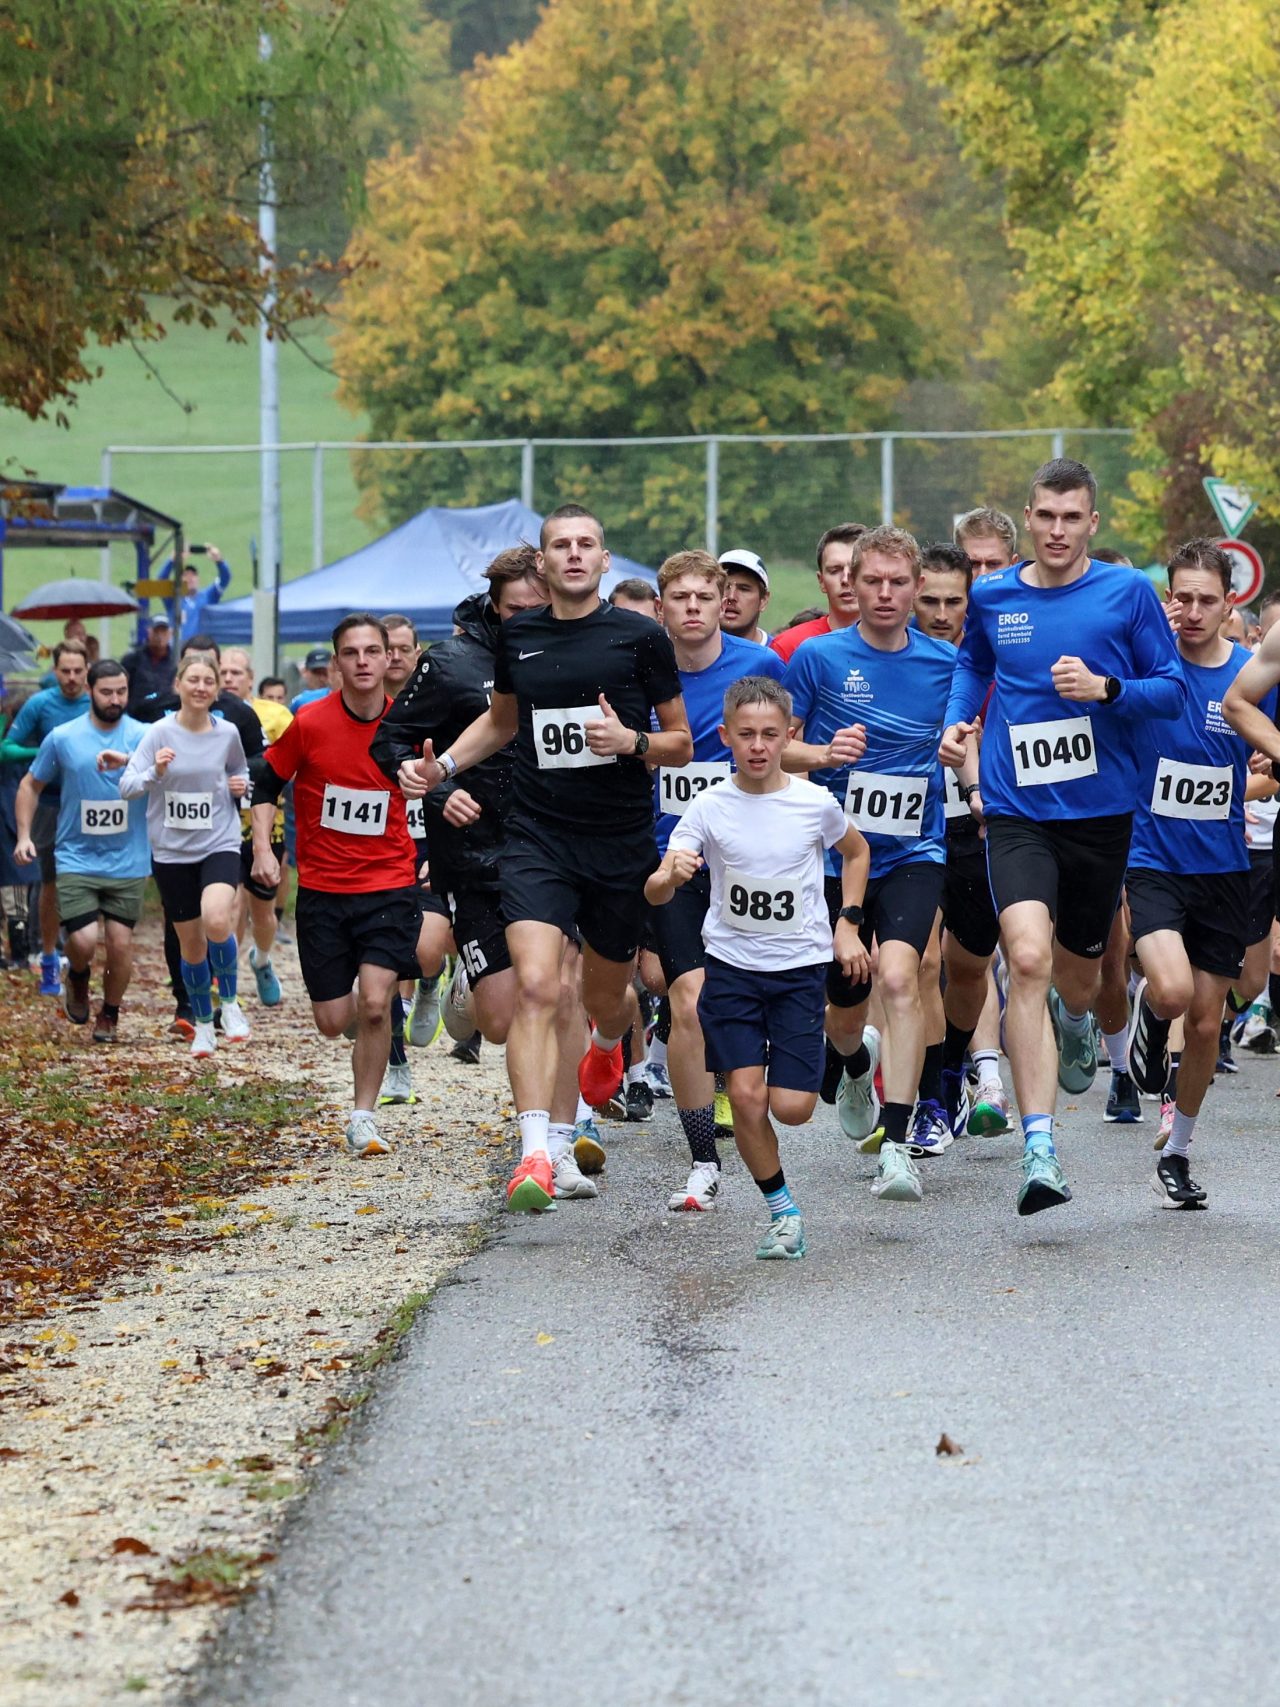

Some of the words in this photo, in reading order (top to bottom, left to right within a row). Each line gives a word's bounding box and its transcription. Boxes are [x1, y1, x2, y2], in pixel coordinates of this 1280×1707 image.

[998, 612, 1029, 626] ERGO
[1207, 699, 1222, 714] ER
[542, 722, 590, 756] 96
[1015, 733, 1092, 770] 1040
[850, 787, 923, 820] 1012
[1159, 774, 1231, 806] 1023
[86, 808, 124, 827] 820
[168, 801, 210, 820] 1050
[326, 796, 382, 824] 1141
[729, 884, 795, 922] 983
